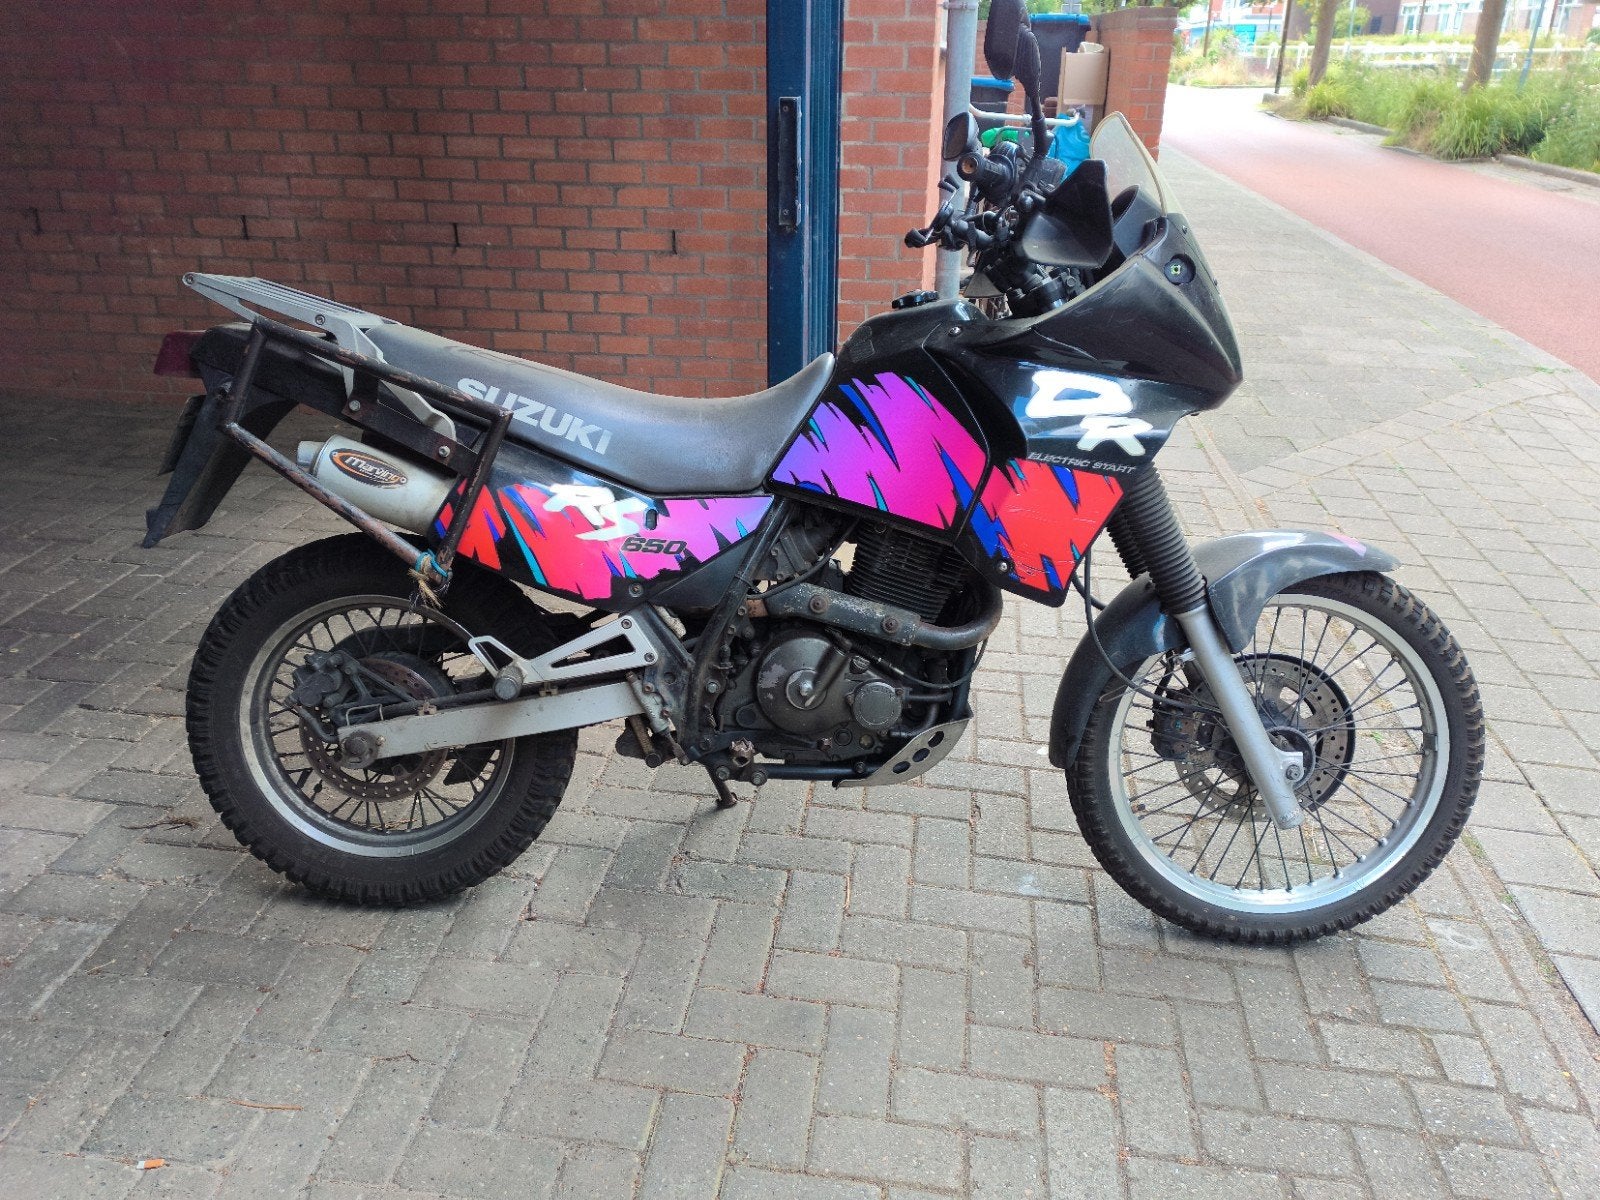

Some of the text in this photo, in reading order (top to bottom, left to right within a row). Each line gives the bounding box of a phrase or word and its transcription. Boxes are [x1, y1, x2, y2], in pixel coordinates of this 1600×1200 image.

[1028, 452, 1136, 474] ELECTRIC START
[621, 537, 687, 554] 650
